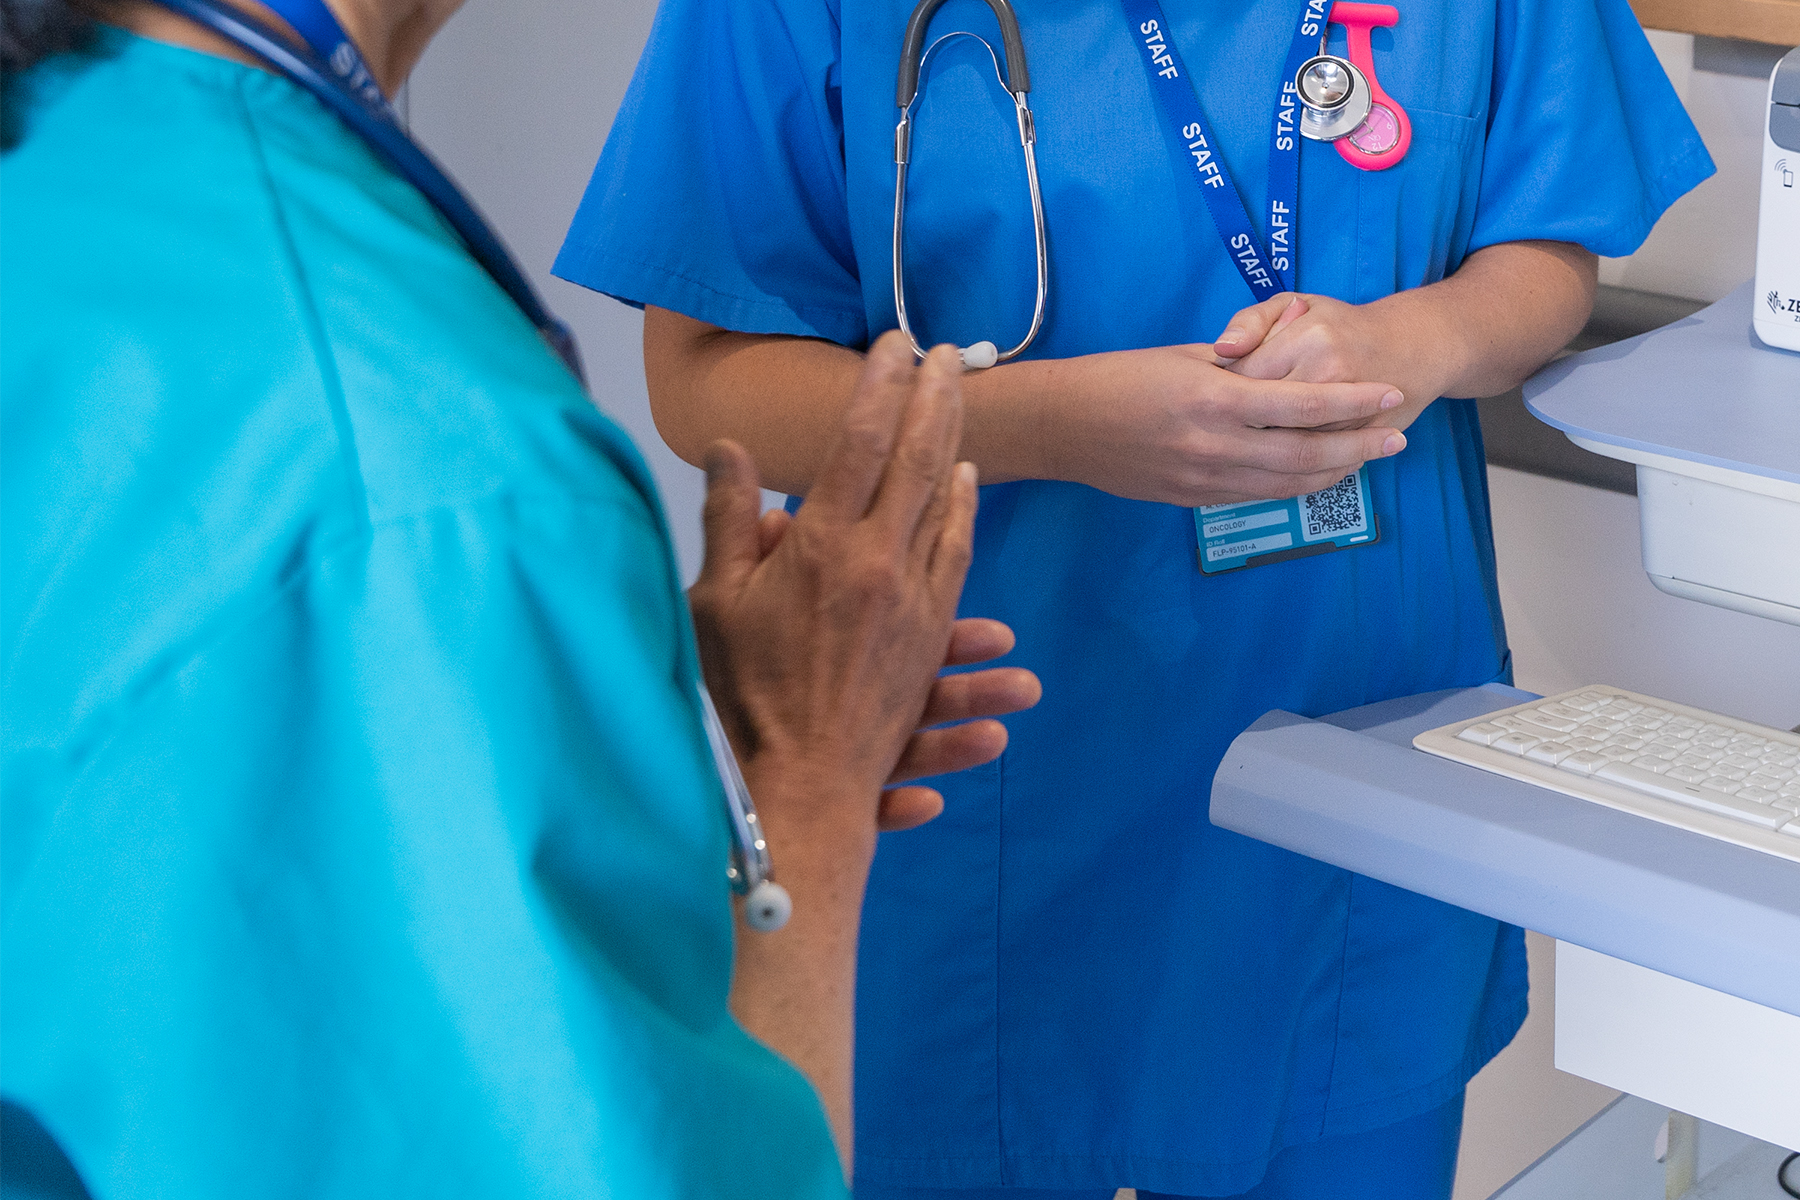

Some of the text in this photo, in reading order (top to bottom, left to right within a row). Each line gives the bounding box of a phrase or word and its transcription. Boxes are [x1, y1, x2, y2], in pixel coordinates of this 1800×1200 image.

[1140, 19, 1179, 80] STAFF
[1276, 80, 1298, 152] STAFF
[1182, 122, 1225, 189] STAFF
[1230, 233, 1273, 291] STAFF
[1272, 200, 1290, 272] STAFF
[1203, 512, 1236, 524] Department
[1209, 520, 1247, 533] ONCOLOGY
[1212, 543, 1257, 557] FLP-95101-A
